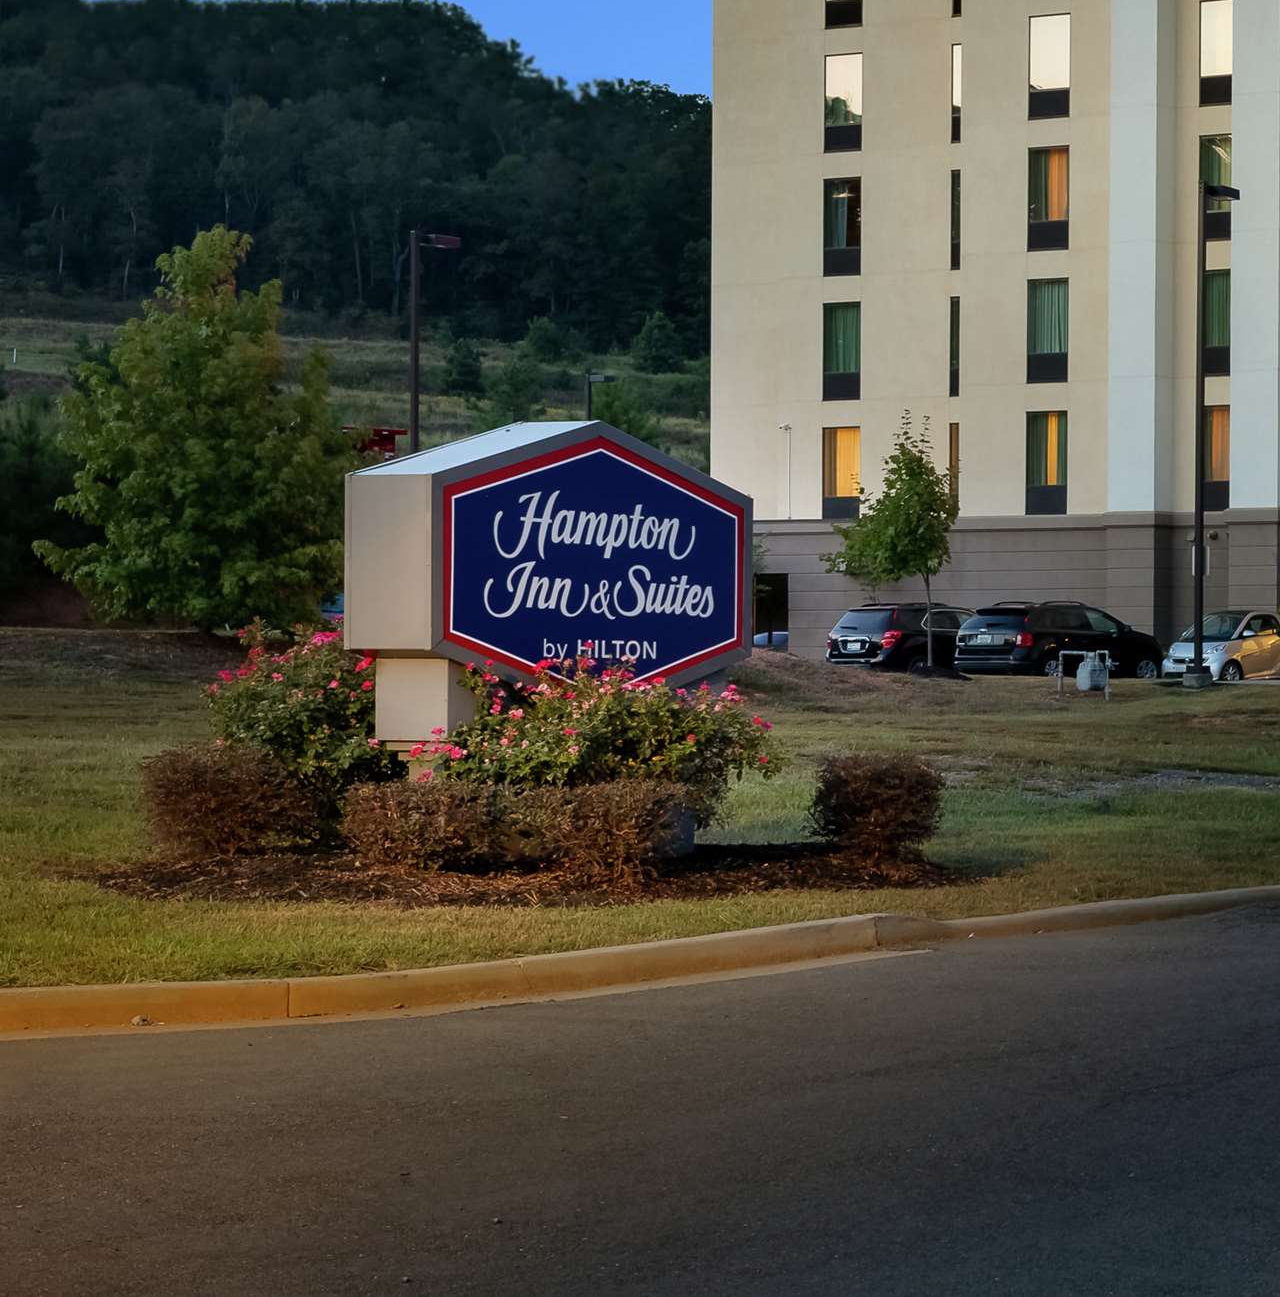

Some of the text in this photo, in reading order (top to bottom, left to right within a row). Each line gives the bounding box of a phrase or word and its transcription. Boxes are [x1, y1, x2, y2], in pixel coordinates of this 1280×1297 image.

[493, 489, 696, 560] Hampton
[483, 560, 715, 620] Inn & Suites
[543, 638, 657, 661] by HILTON
